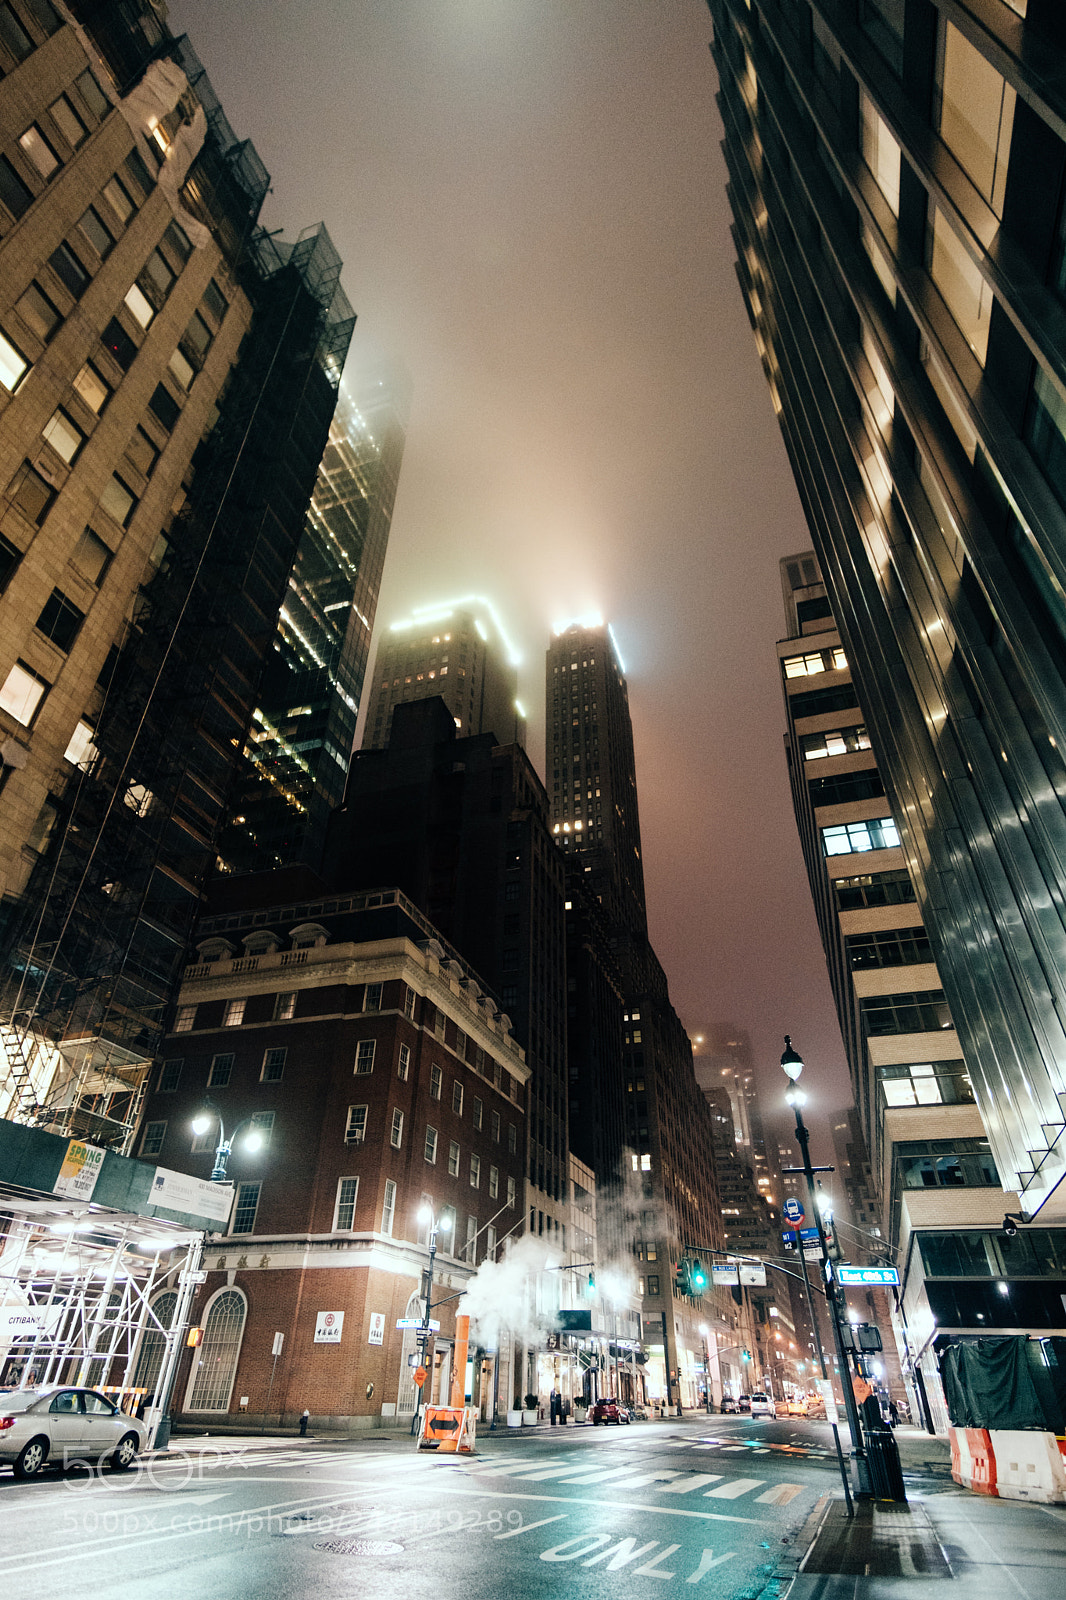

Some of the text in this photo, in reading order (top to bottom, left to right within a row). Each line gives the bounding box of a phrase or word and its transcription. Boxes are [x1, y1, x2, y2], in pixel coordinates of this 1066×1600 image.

[69, 1145, 102, 1164] SPRING
[784, 1242, 793, 1250] M2
[841, 1271, 862, 1281] East
[883, 1271, 894, 1281] St
[539, 1533, 738, 1584] ONLY
